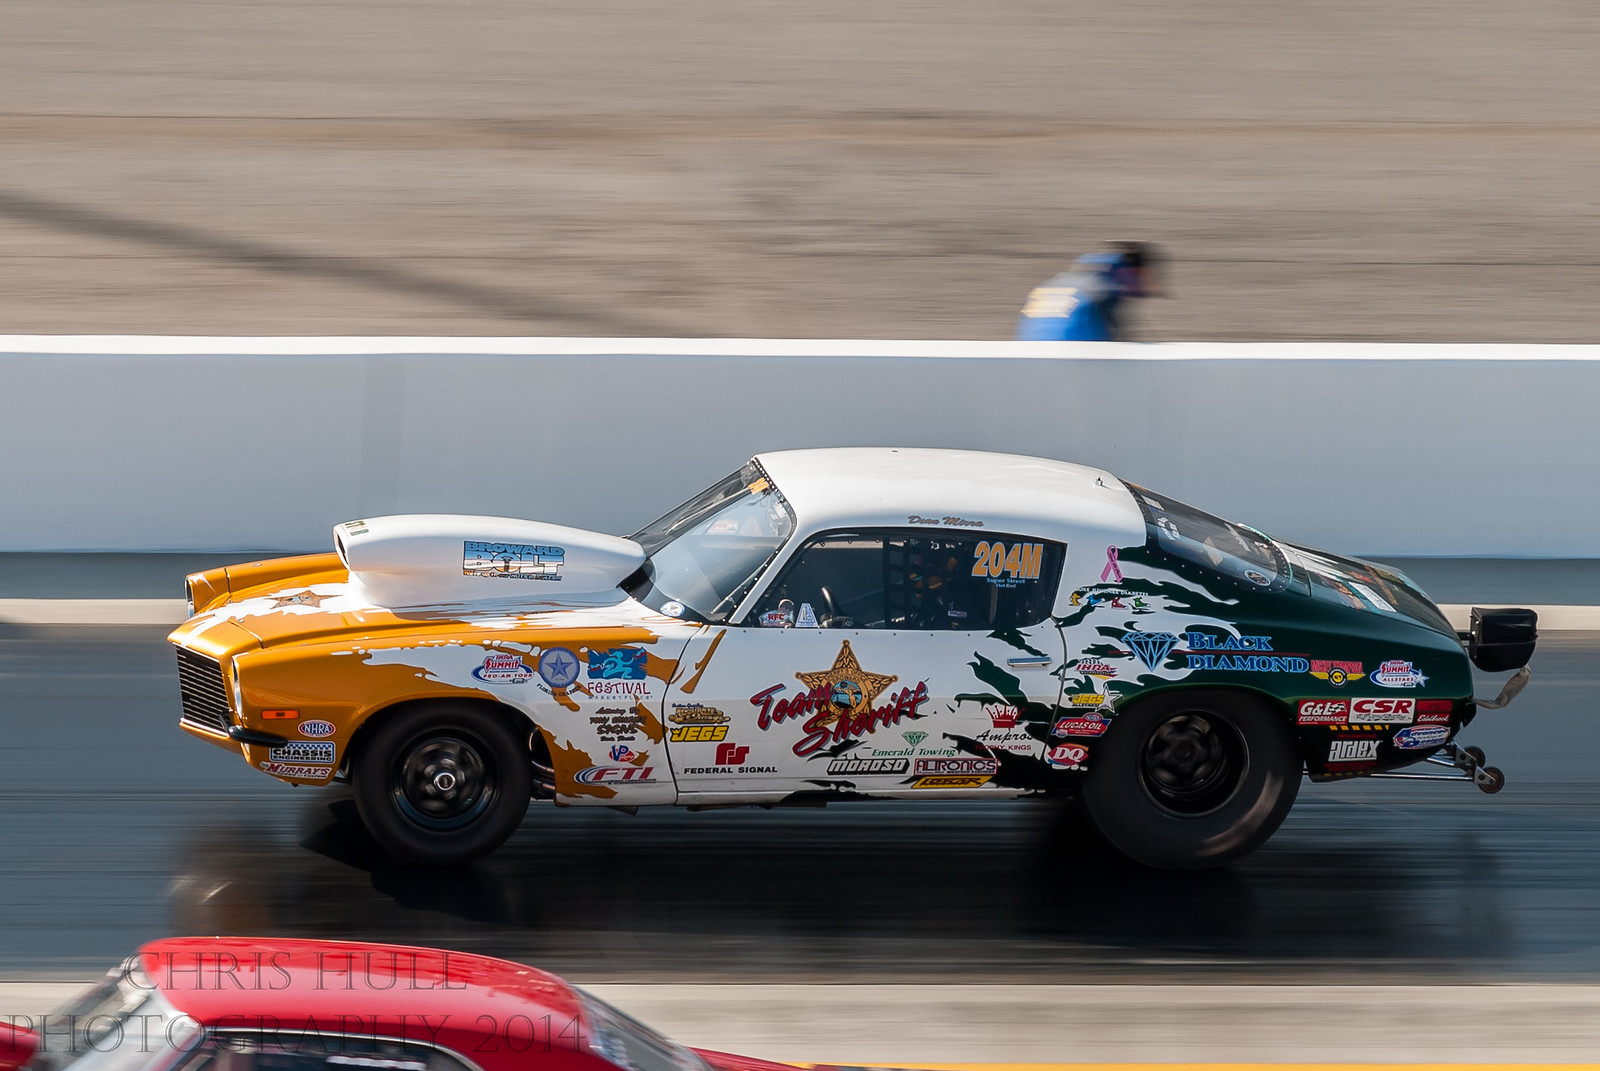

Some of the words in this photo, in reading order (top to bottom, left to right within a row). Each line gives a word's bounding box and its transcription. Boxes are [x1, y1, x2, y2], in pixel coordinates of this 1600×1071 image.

[464, 541, 565, 556] BROWARD
[463, 551, 564, 576] BOLT
[971, 540, 1044, 580] 204M
[767, 613, 785, 622] RFC
[1186, 631, 1274, 652] BLACK
[1186, 654, 1310, 674] DIAMOND
[587, 681, 651, 695] FESTIVAL
[1072, 694, 1105, 704] JEGS
[750, 683, 839, 731] Team
[1300, 702, 1334, 716] G&L
[1353, 700, 1413, 714] CSR
[792, 681, 931, 757] Sheriff
[1417, 714, 1450, 722] Edelbrock
[304, 722, 331, 735] NHRA
[1060, 721, 1088, 730] LUCAS
[1088, 722, 1103, 731] OIL
[671, 726, 729, 742] JEGS
[273, 749, 332, 757] CHASSIS
[611, 745, 629, 762] VP
[871, 748, 914, 757] Emerald
[918, 748, 956, 758] Towing
[1053, 747, 1085, 763] DQ
[1328, 740, 1380, 762] ardex
[266, 763, 331, 776] MURRAY'S
[683, 767, 734, 775] FEDERAL
[737, 766, 778, 774] SIGNAL
[828, 758, 908, 773] MOROSO
[592, 767, 655, 781] FTI
